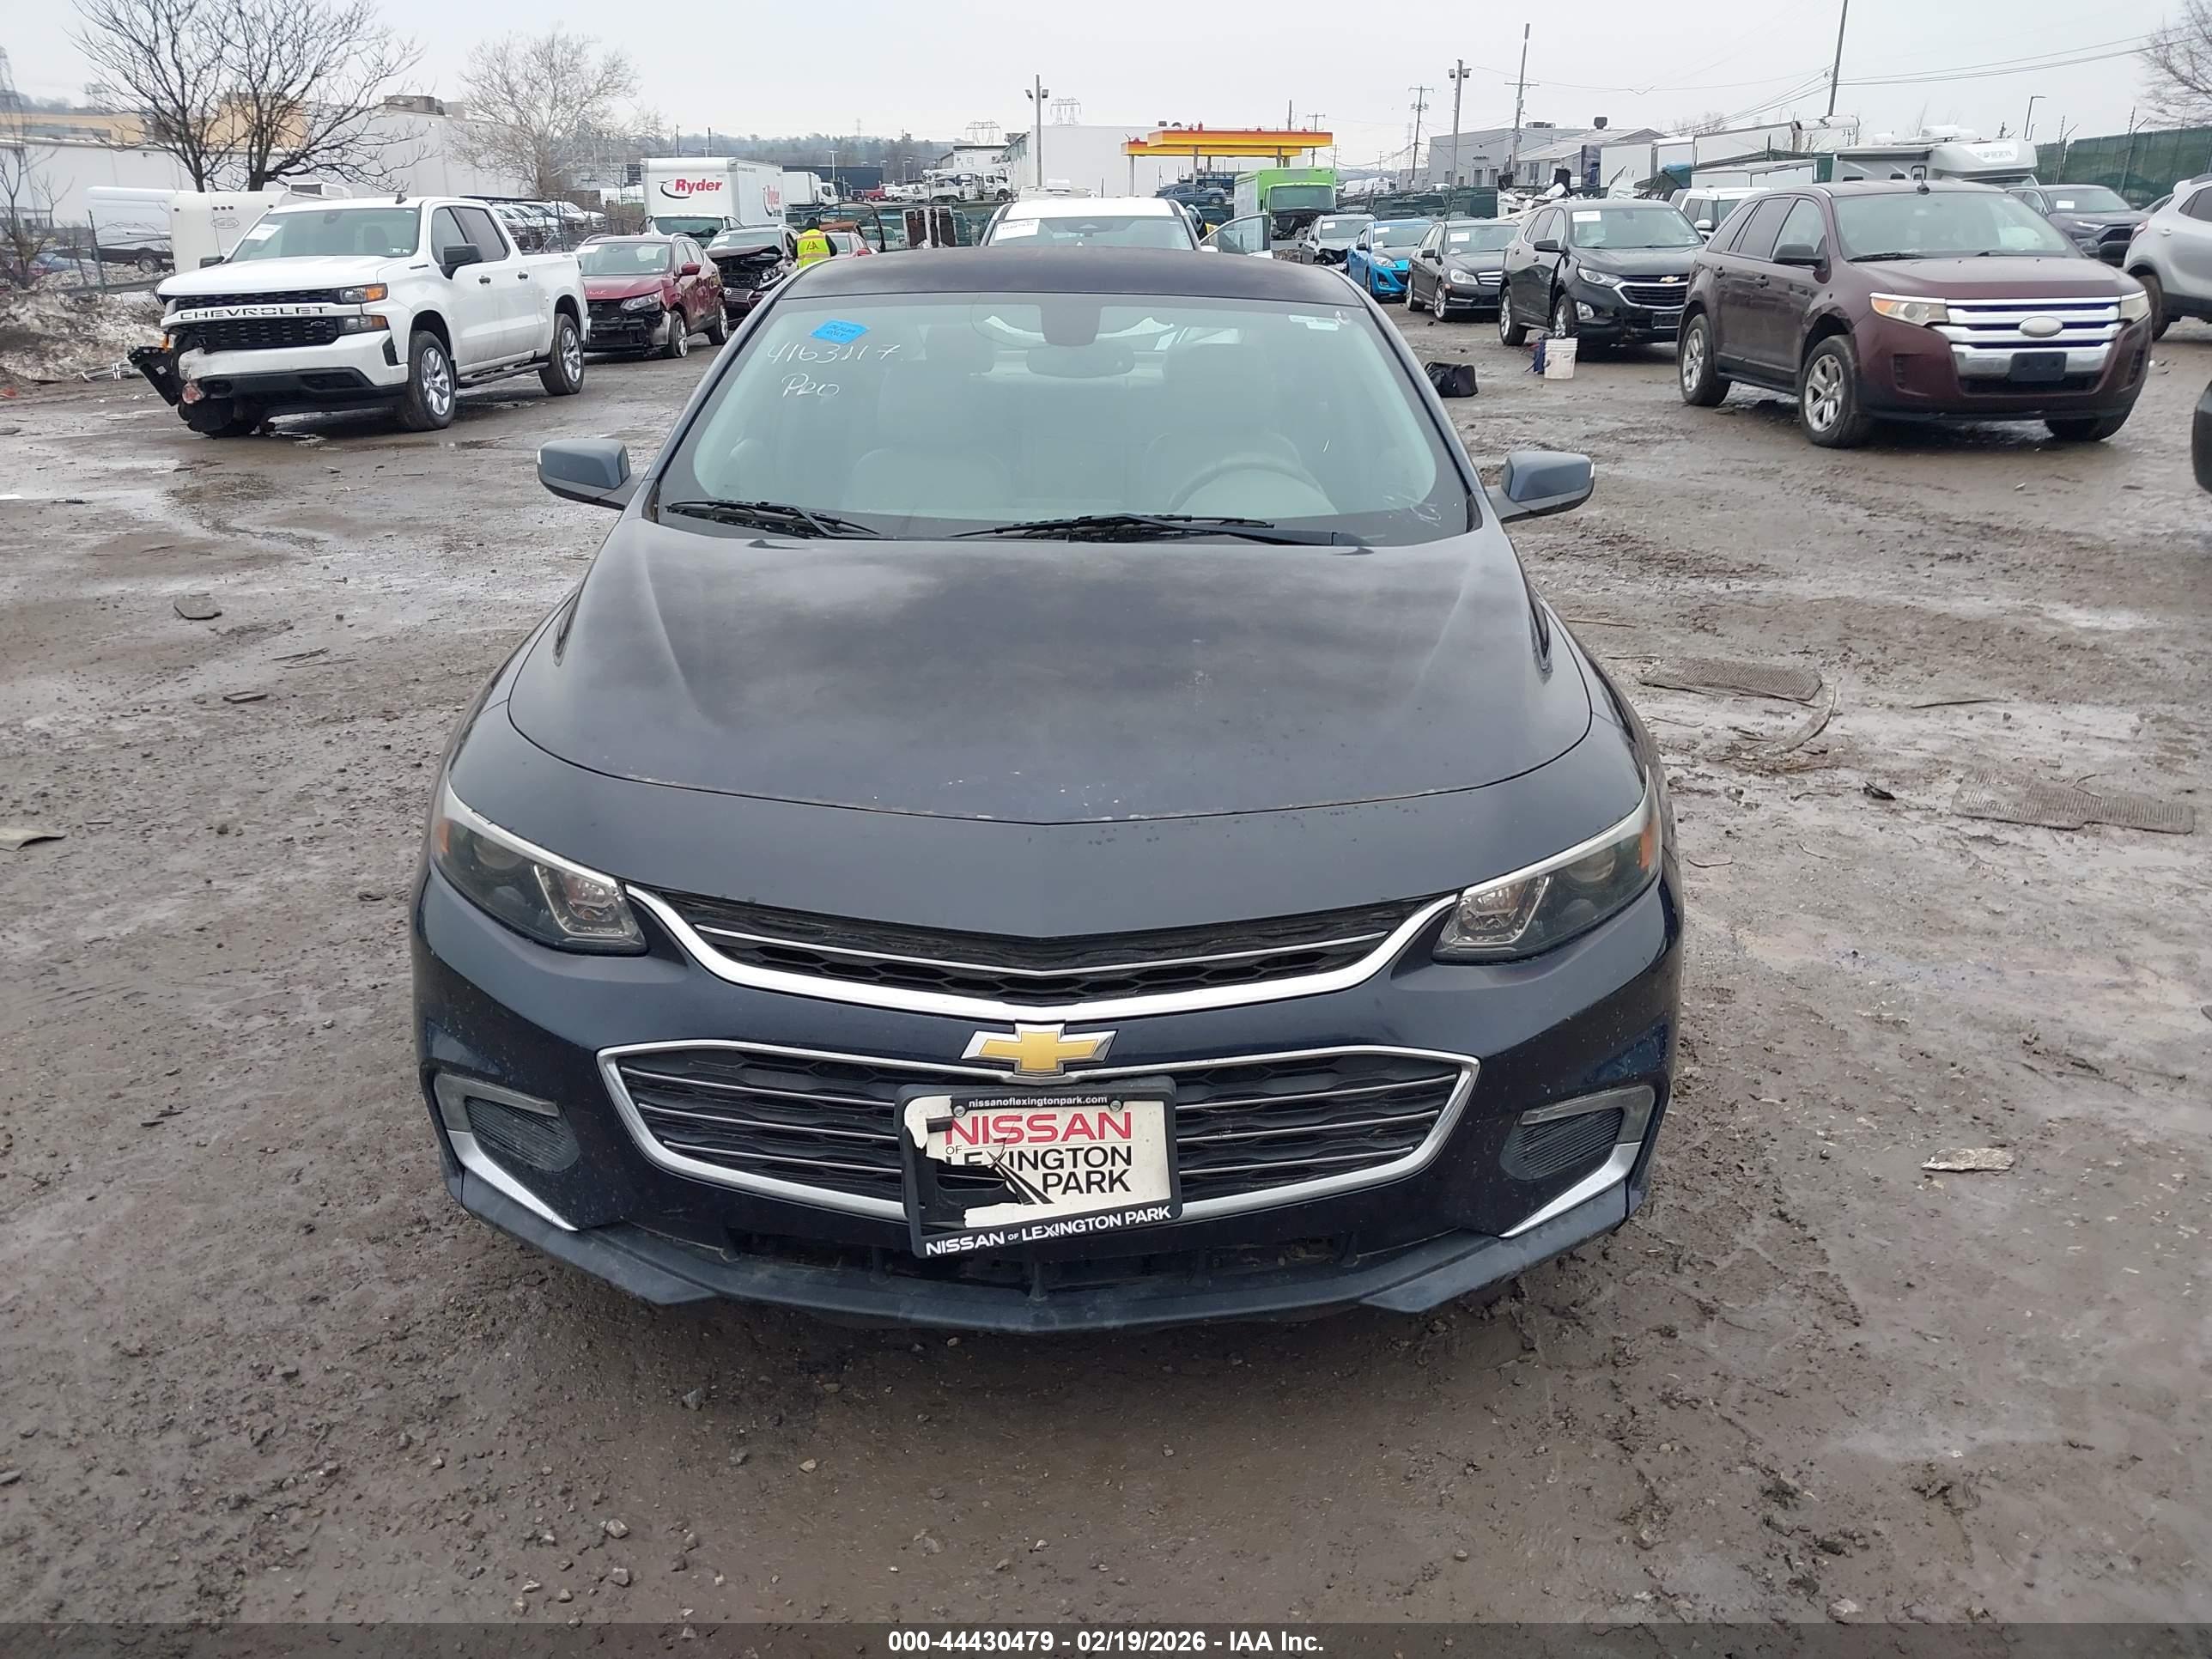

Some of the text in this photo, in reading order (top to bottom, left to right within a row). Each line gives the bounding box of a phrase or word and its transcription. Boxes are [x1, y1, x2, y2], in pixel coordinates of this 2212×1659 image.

[674, 178, 723, 194] Ryder
[180, 306, 328, 320] CHEVROLET
[968, 1095, 1109, 1109] nissanoflexingtonpark.com
[945, 1111, 1132, 1146] NISSAN
[945, 1145, 963, 1155] OF
[1042, 1168, 1133, 1196] PARK
[926, 1205, 1172, 1256] NISSAN OF LEXINGTON PARK
